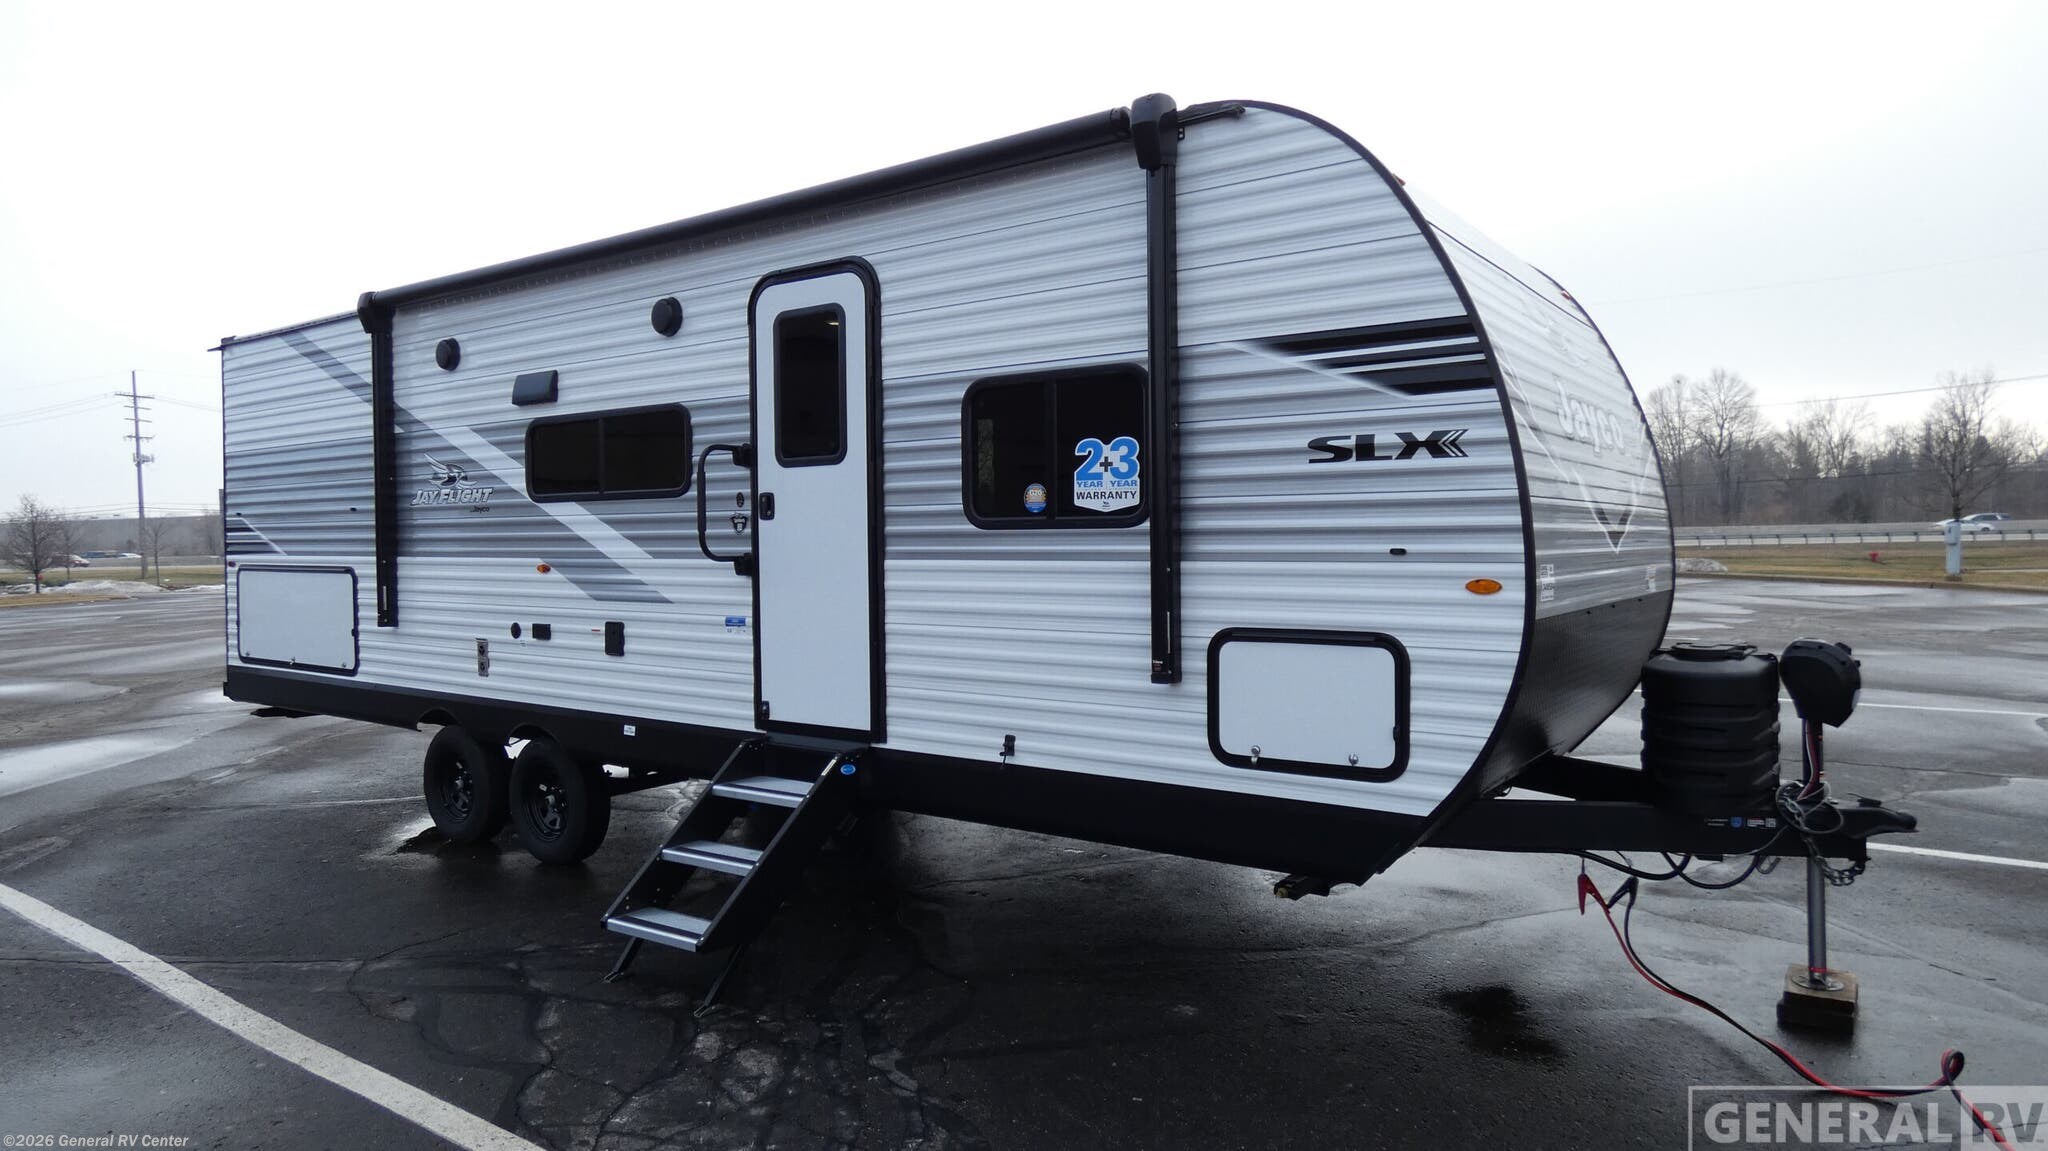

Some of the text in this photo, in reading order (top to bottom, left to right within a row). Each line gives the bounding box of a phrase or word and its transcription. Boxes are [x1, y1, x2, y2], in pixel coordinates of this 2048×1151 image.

[1556, 379, 1625, 454] Jayco
[1307, 429, 1469, 464] SLX
[1076, 480, 1138, 489] YEAR YEAR
[410, 487, 494, 505] JAY FLIGHT
[1076, 490, 1138, 500] WARRANTY
